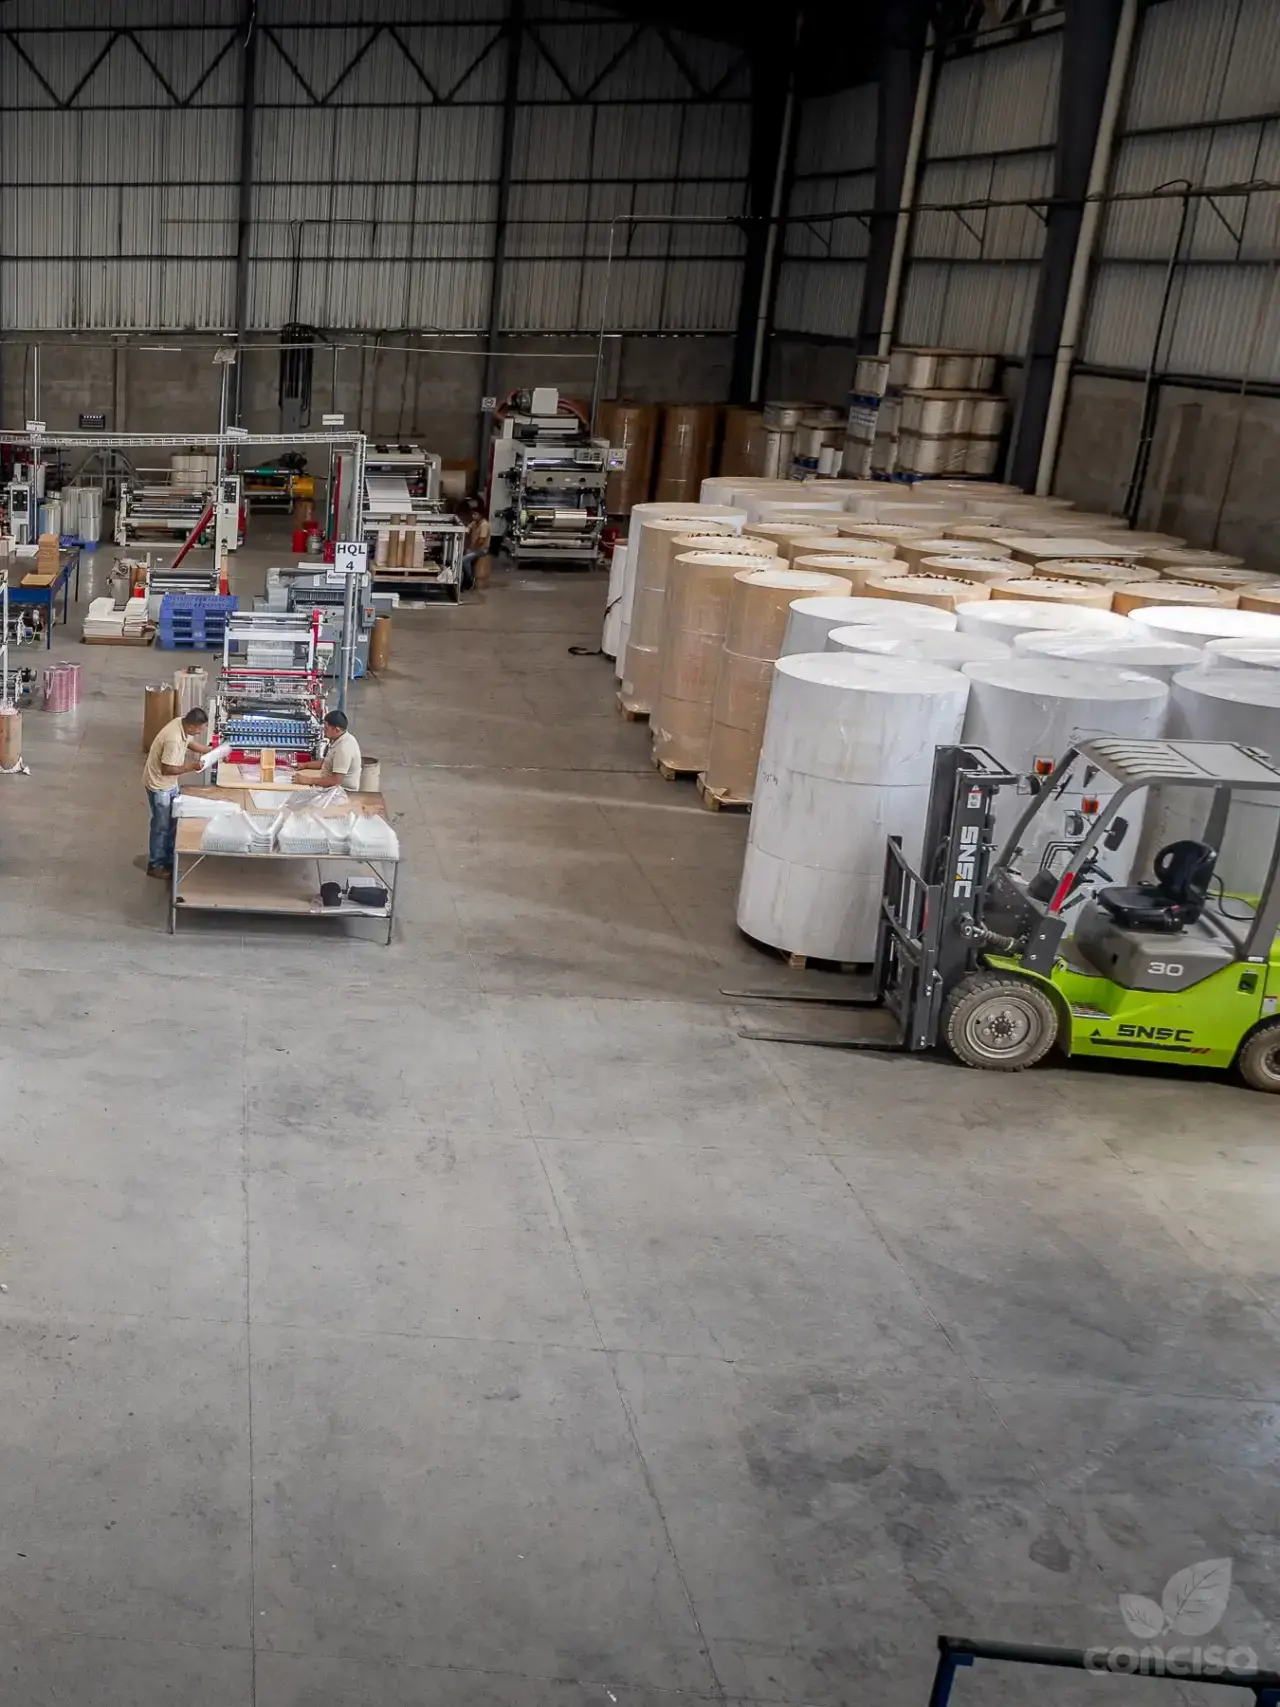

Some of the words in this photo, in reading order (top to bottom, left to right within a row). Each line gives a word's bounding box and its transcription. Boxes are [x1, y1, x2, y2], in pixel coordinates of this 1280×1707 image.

[337, 544, 366, 556] HQL
[345, 561, 355, 570] 4
[953, 826, 979, 898] SNSC
[1147, 961, 1184, 976] 30
[1117, 1023, 1194, 1043] SNSC
